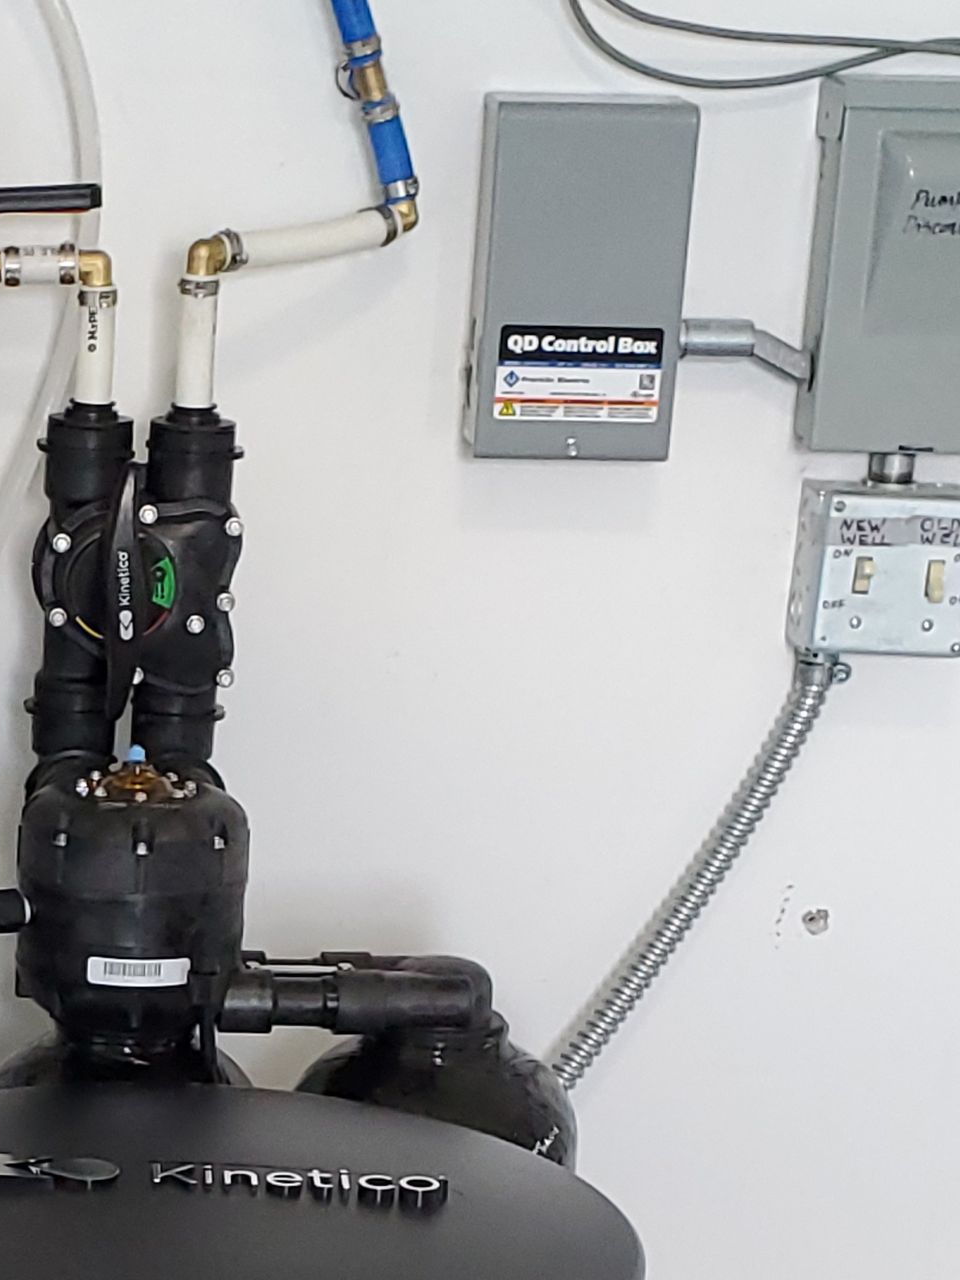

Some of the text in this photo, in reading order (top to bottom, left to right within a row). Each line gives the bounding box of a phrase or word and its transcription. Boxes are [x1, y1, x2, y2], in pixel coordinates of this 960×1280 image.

[507, 334, 658, 355] QD Control Box
[840, 518, 886, 533] NEW
[841, 534, 892, 547] WELL
[833, 549, 853, 559] ON
[117, 551, 130, 606] Kinetico
[822, 599, 845, 609] OFF
[151, 1163, 442, 1193] Kinetico
